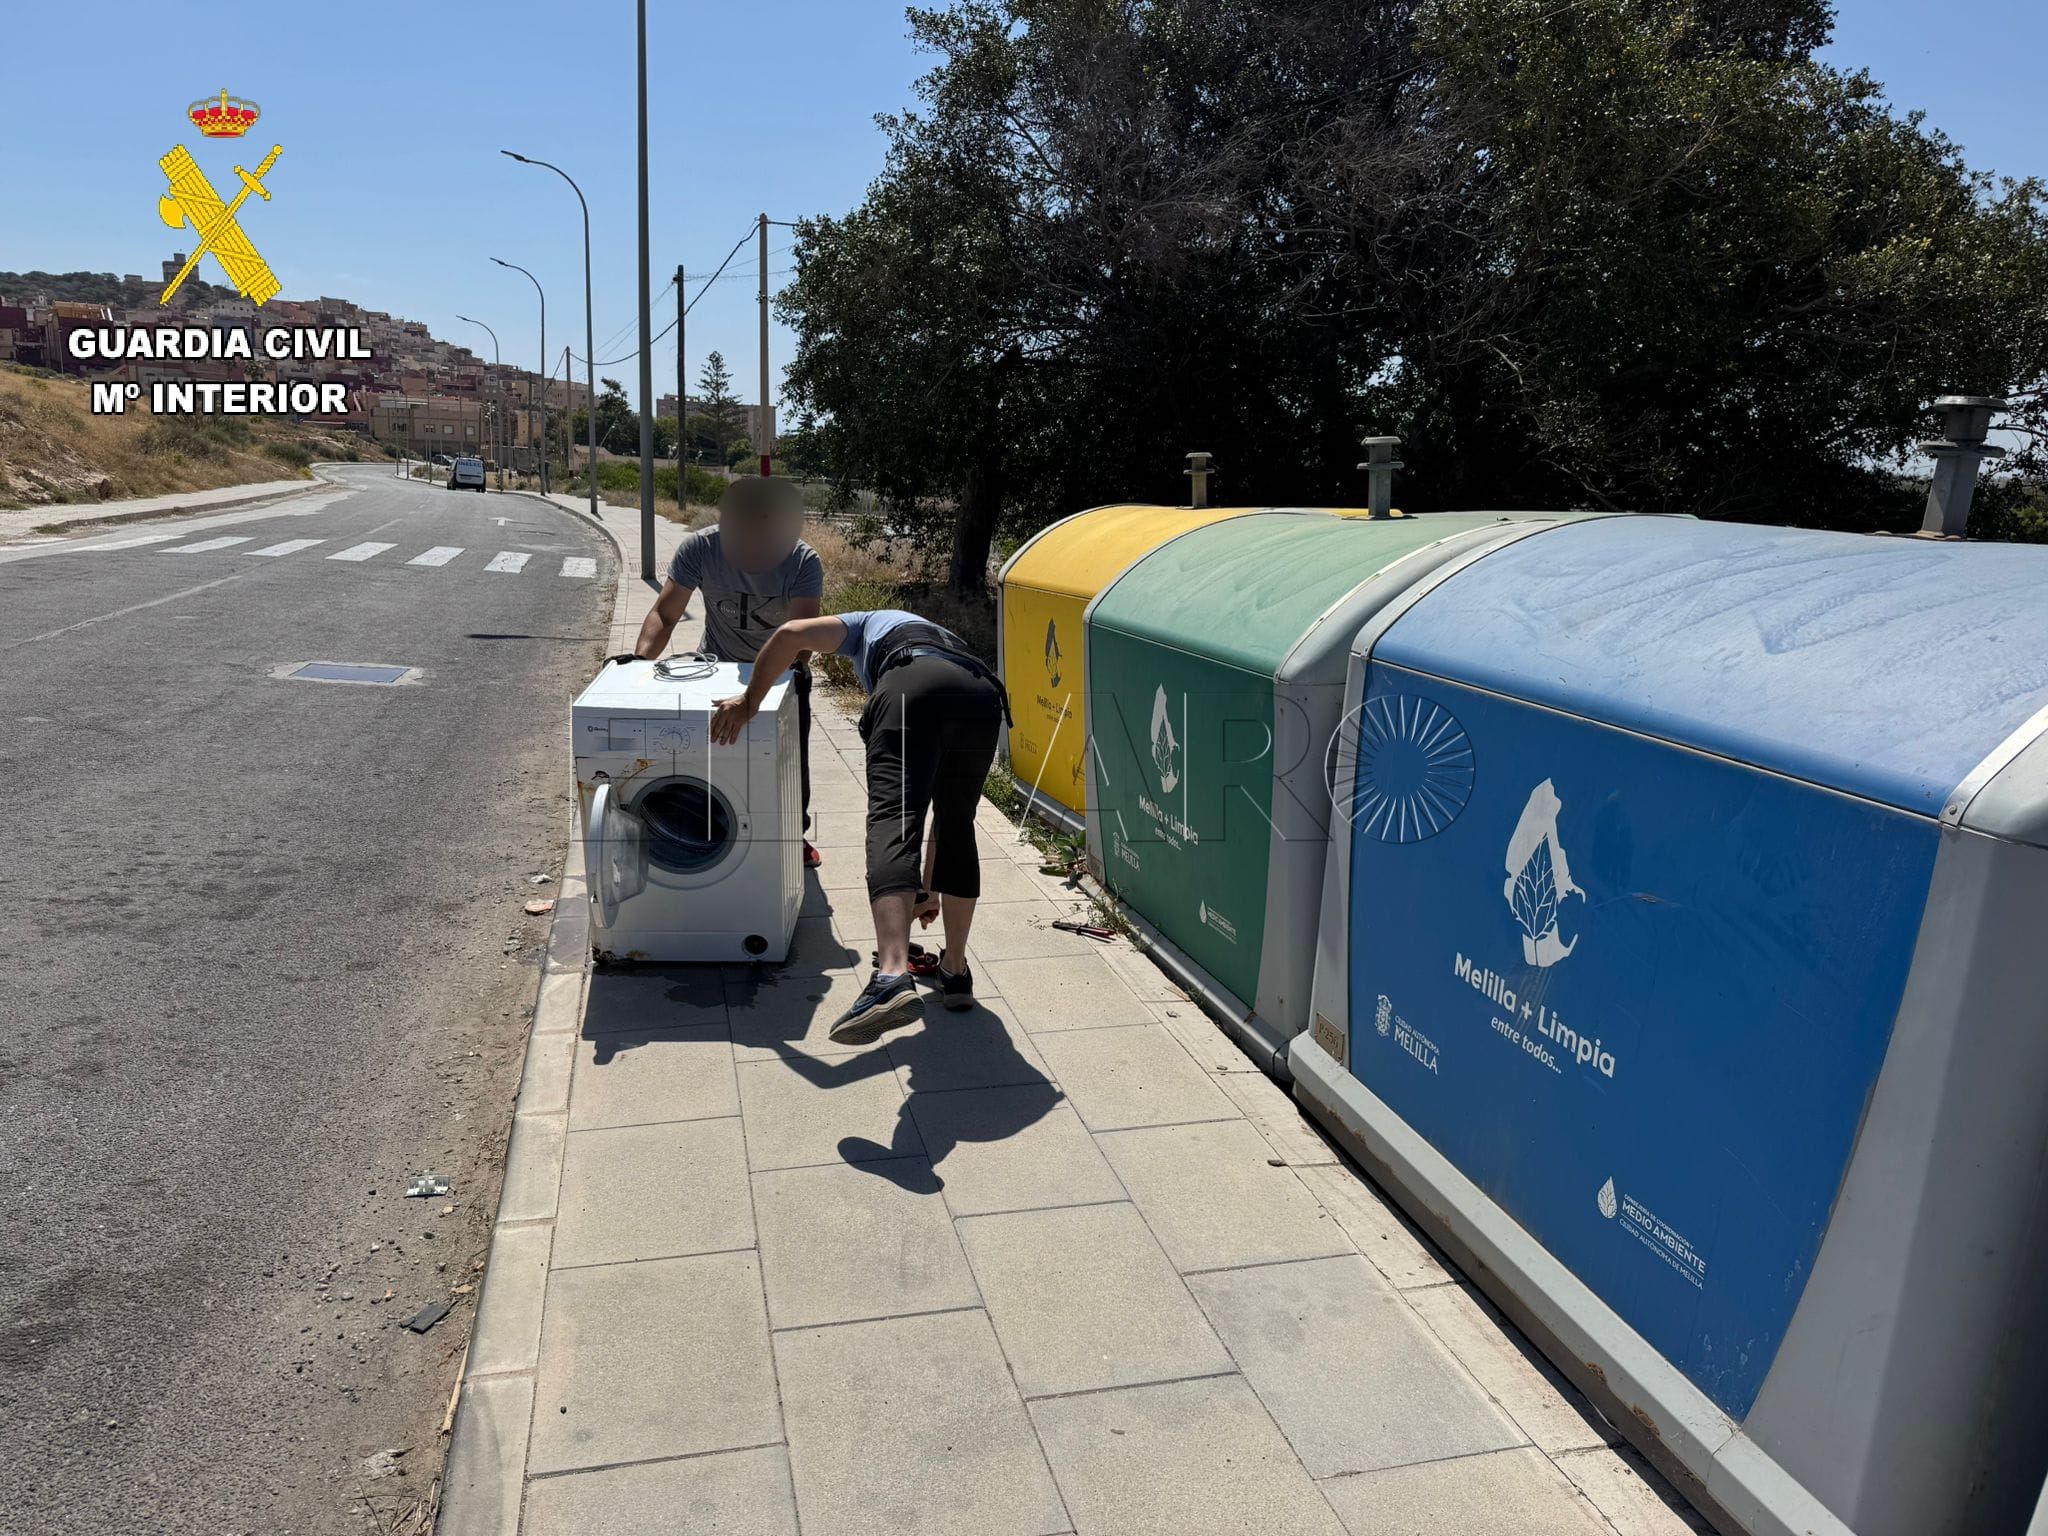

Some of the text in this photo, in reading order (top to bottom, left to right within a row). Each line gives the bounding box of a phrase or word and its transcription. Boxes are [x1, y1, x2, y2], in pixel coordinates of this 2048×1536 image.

[1139, 794, 1163, 822] Melilla
[1170, 814, 1199, 846] Limpia
[1454, 952, 1616, 1079] Melilla + Limpia
[1491, 1016, 1521, 1044] entre
[1394, 1024, 1438, 1075] MELILLA
[1619, 1218, 1639, 1238] CIUDAD
[1672, 1260, 1680, 1271] DE
[1680, 1266, 1703, 1291] MELILLA
[1622, 1199, 1707, 1274] MEDIO AMBIENTE
